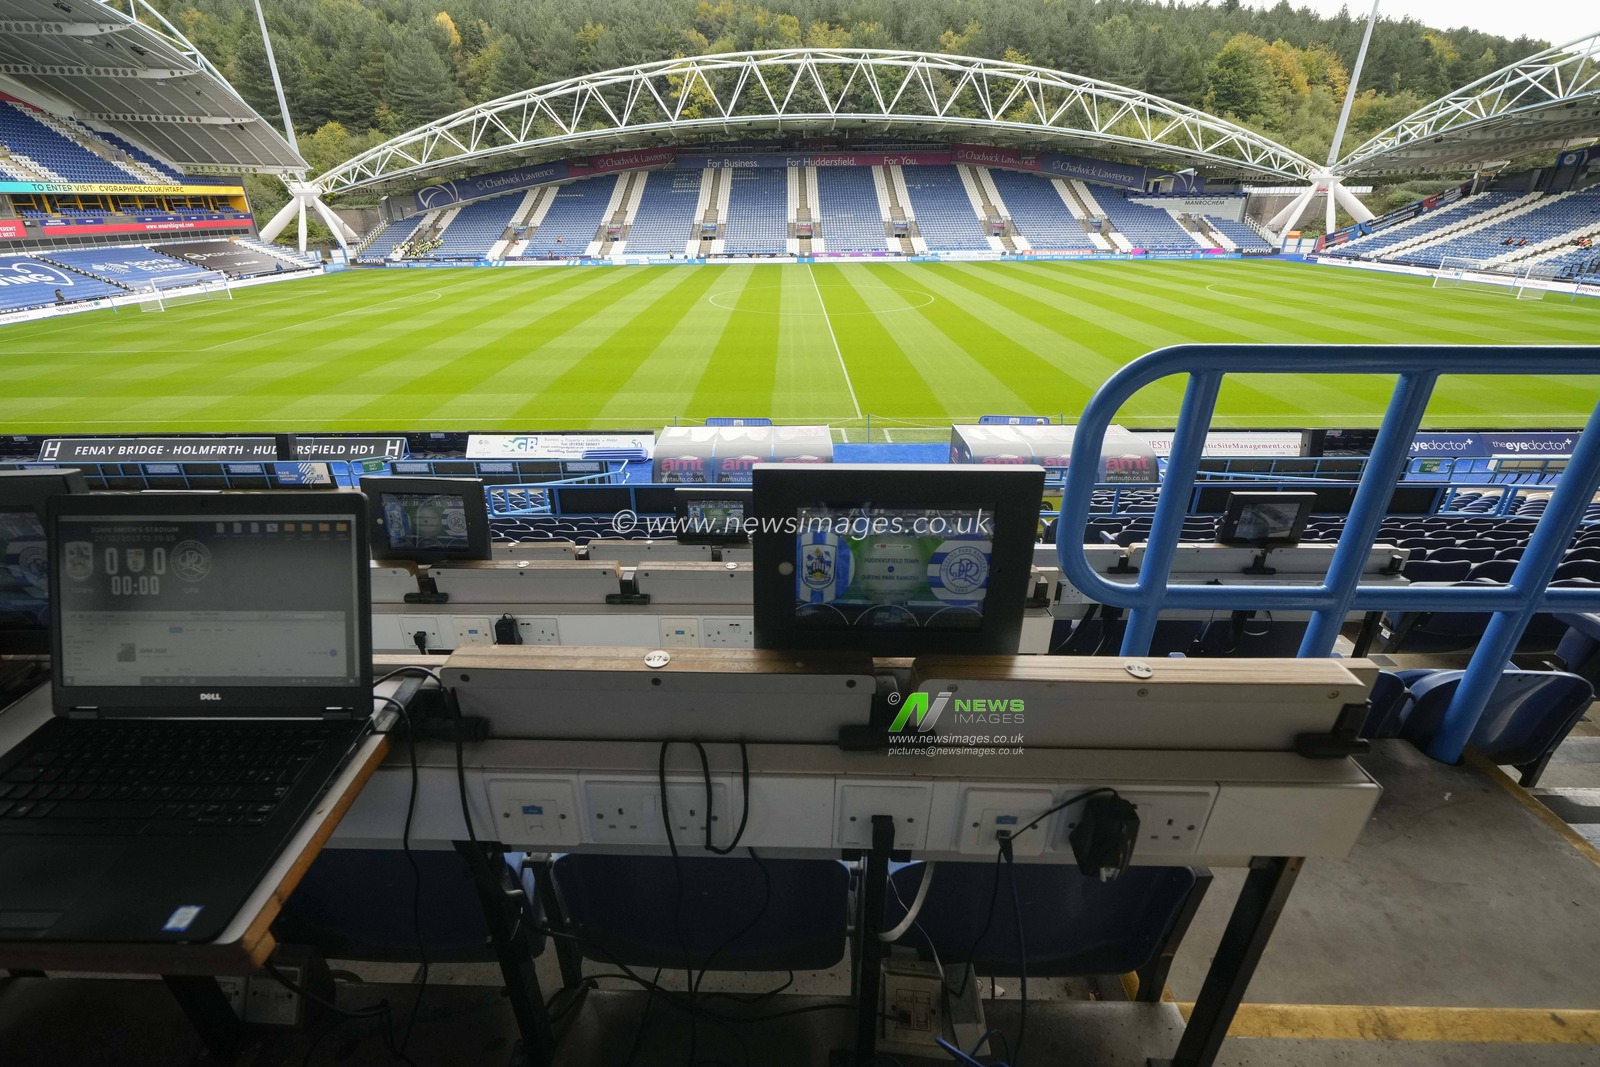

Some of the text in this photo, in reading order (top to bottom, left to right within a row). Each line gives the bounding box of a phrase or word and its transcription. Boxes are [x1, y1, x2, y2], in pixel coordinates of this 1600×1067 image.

[605, 151, 672, 168] Chadwick Lawrence
[707, 158, 760, 168] For Business.
[786, 157, 856, 167] For Huddersfield.
[884, 156, 918, 166] For You.
[965, 151, 1000, 162] Chadwick
[485, 167, 554, 189] Chadwick Lawrence
[1060, 160, 1134, 183] Chadwick Lawrence
[32, 184, 44, 192] TO
[45, 442, 61, 458] H
[75, 446, 115, 456] FENAY
[118, 446, 164, 455] BRIDGE
[172, 445, 244, 454] HOLMFIRTH
[350, 444, 375, 455] HD1
[385, 440, 400, 457] H
[661, 455, 704, 470] amt
[1106, 456, 1150, 470] amt
[105, 547, 118, 575] 0
[152, 547, 166, 575] 0
[112, 576, 160, 596] 00:00
